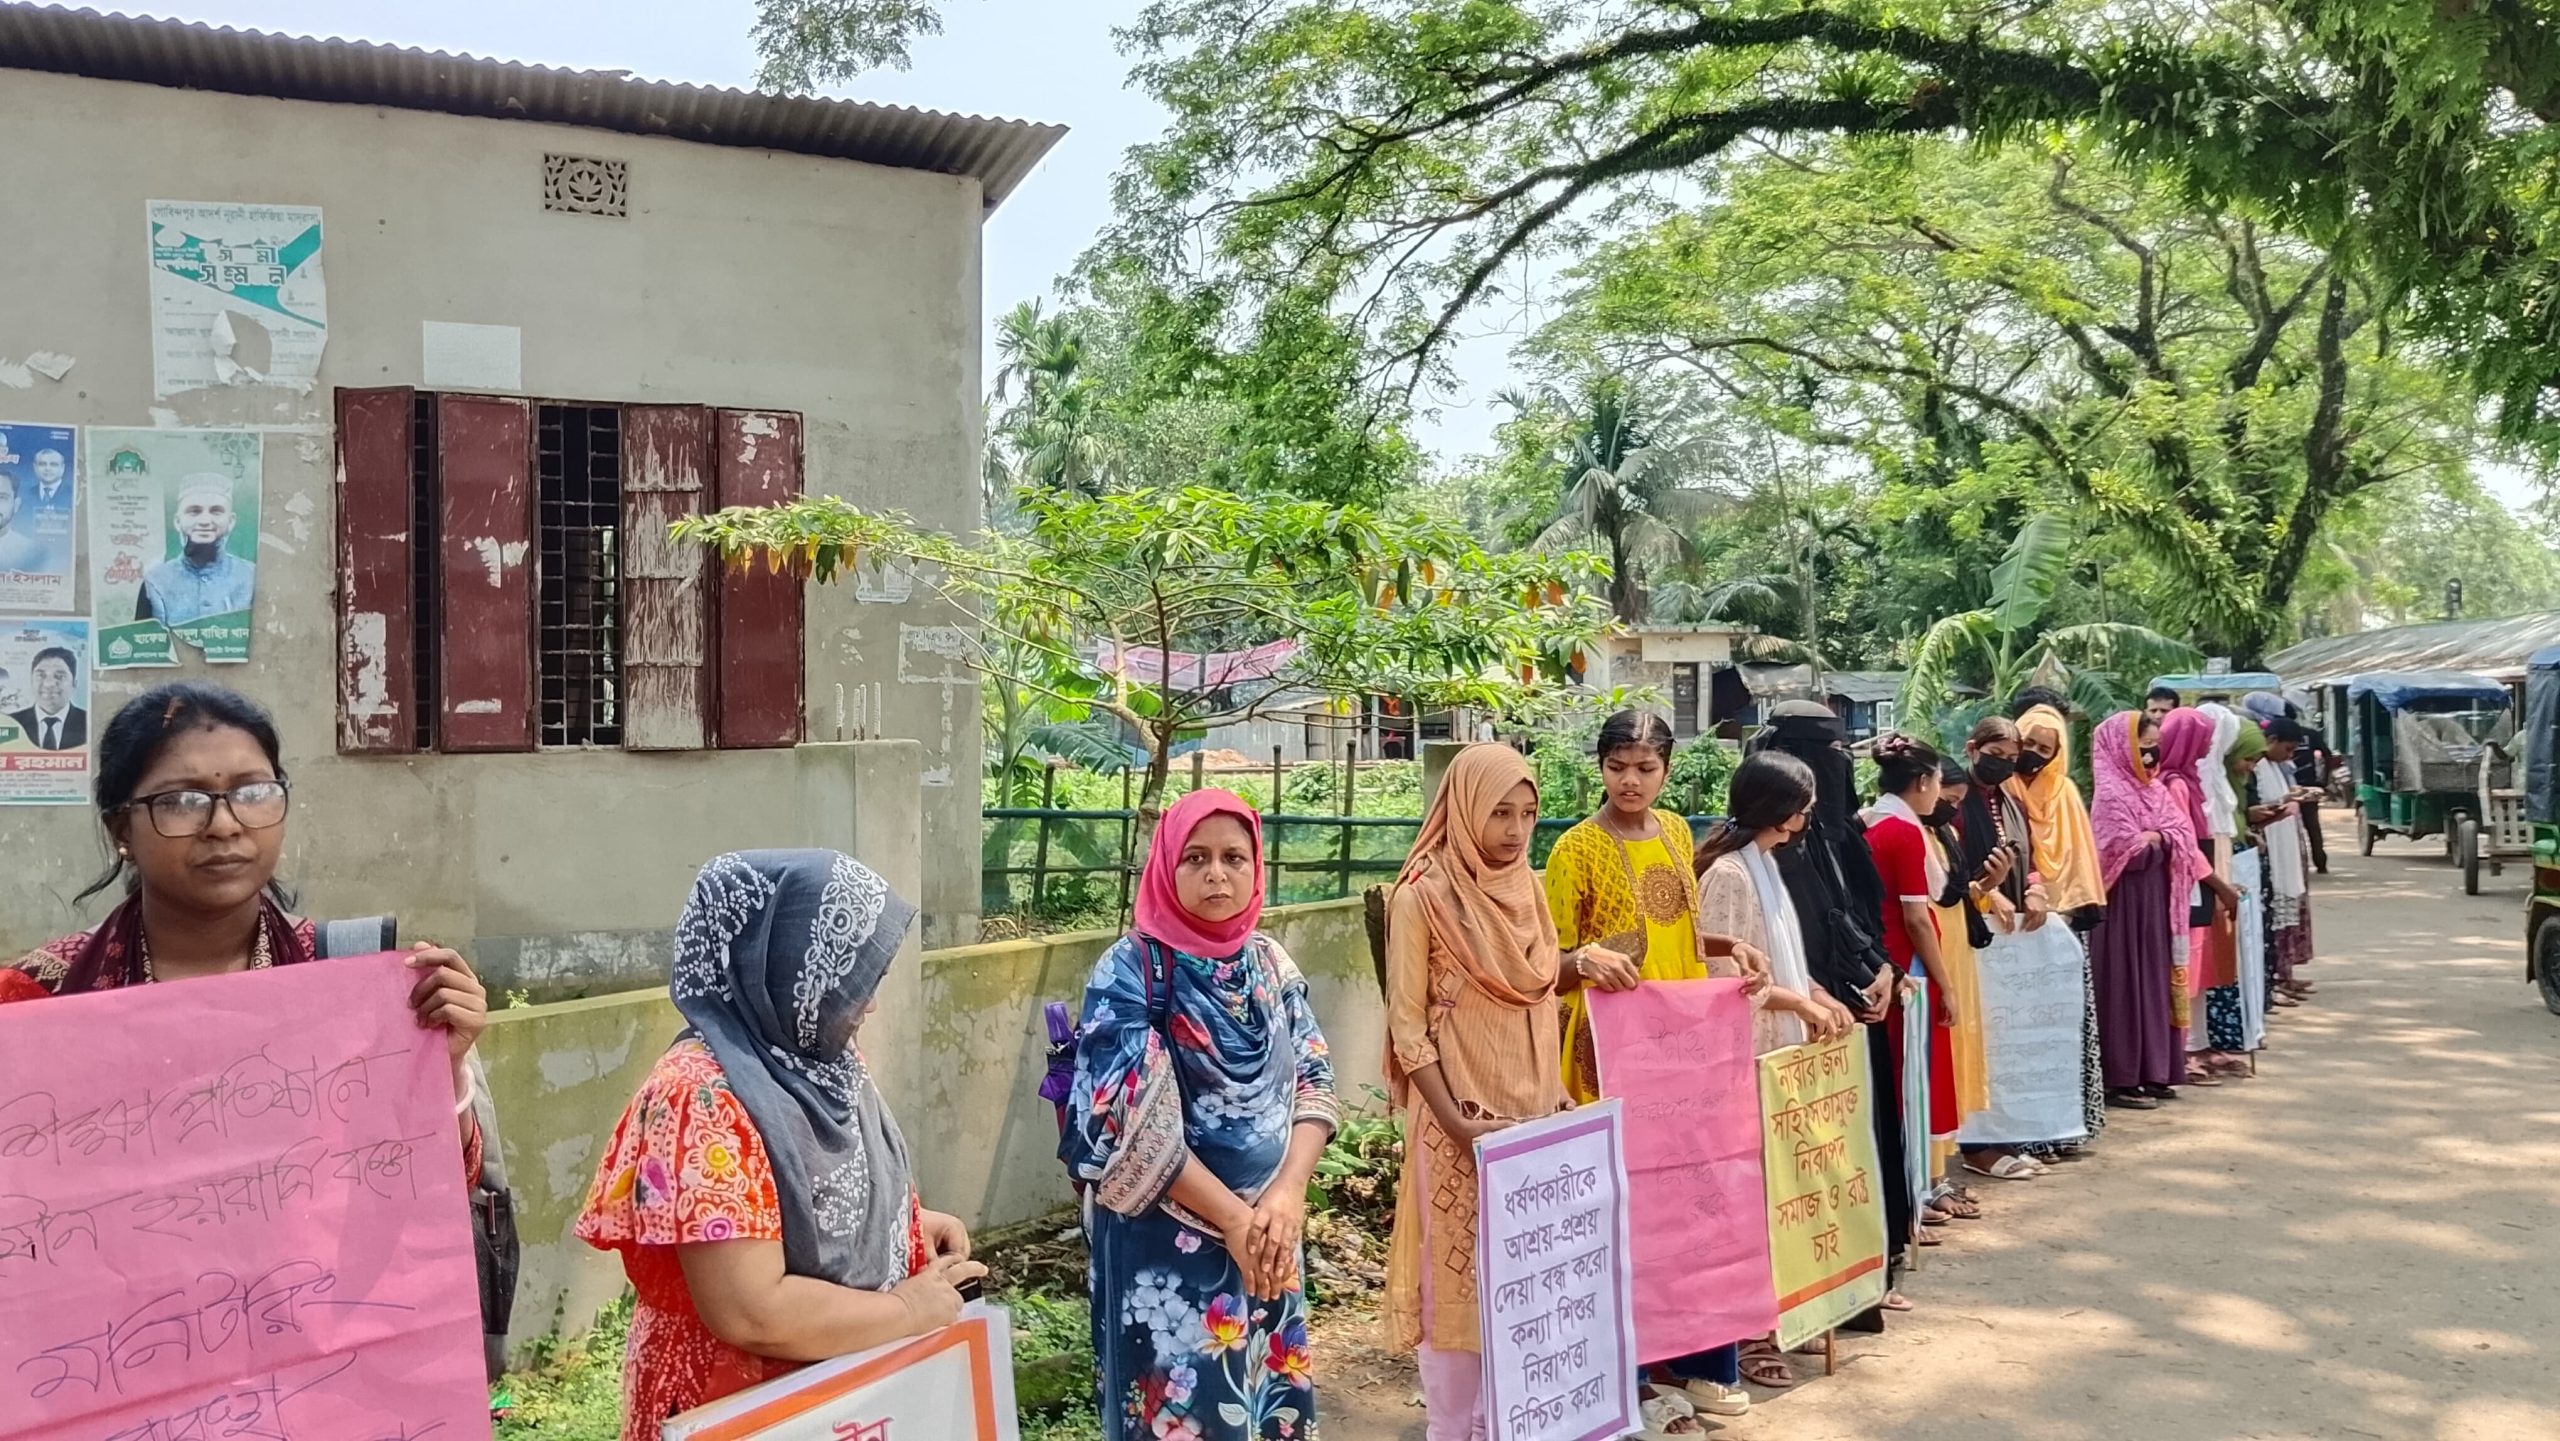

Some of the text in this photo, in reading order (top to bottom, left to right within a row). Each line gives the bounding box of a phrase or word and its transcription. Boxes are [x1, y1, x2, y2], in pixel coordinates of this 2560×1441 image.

[13, 755, 84, 770] রহমান
[1777, 1044, 1850, 1096] নারীর জন্য
[1792, 1134, 1847, 1182] নিরাপদ
[1503, 1163, 1597, 1219] ধর্ষণকারীকে
[1775, 1189, 1822, 1231] সমাজ
[1827, 1183, 1840, 1211] ও
[1503, 1207, 1601, 1263] আশ্রয়-প্রশ্রয়
[1811, 1223, 1840, 1263] চাই
[1494, 1242, 1609, 1314] দেয়া বন্ধ করো
[1508, 1292, 1597, 1349] কন্যা শিশুর
[1521, 1336, 1589, 1393] নিরাপত্তা
[1508, 1372, 1606, 1441] নিশ্চিত করো
